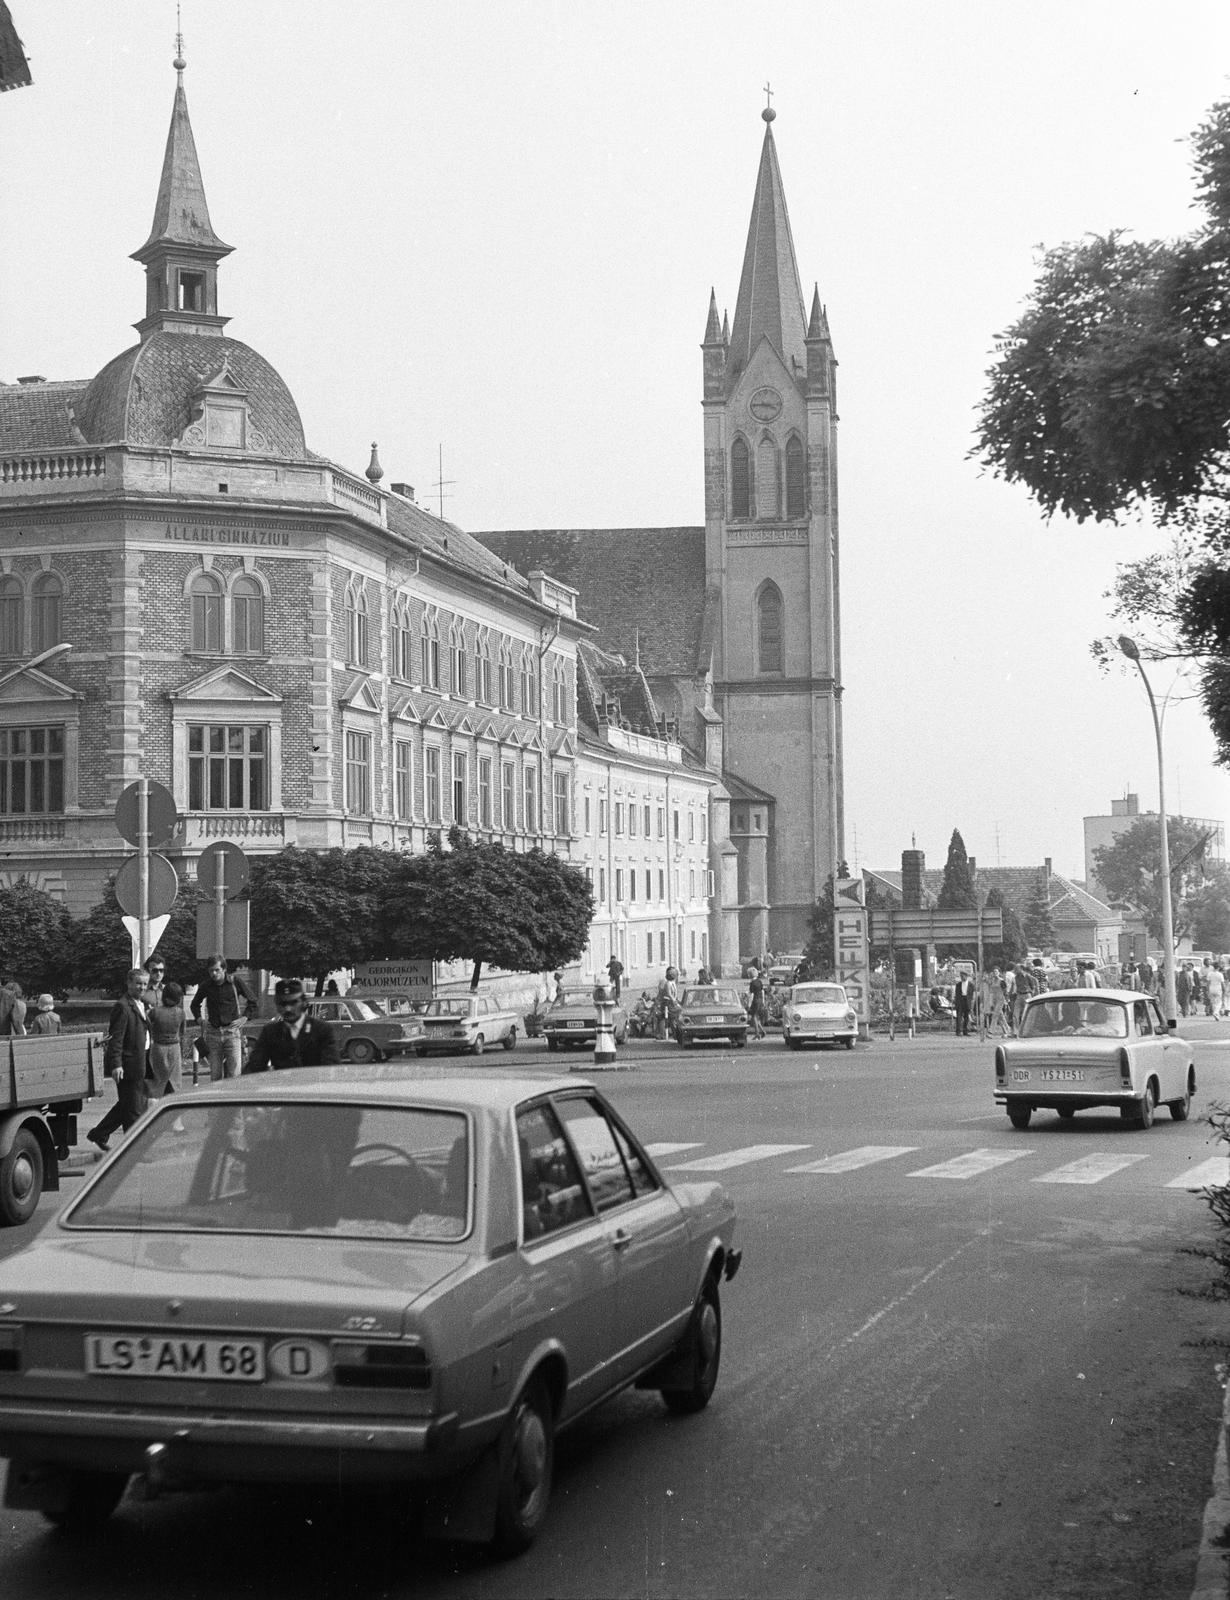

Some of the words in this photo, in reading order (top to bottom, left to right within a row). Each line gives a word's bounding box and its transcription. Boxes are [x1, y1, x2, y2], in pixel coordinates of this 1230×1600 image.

[368, 965, 419, 974] GEORGIKON
[1014, 1070, 1030, 1080] DDR
[219, 1344, 257, 1376] 68
[289, 1346, 312, 1375] D
